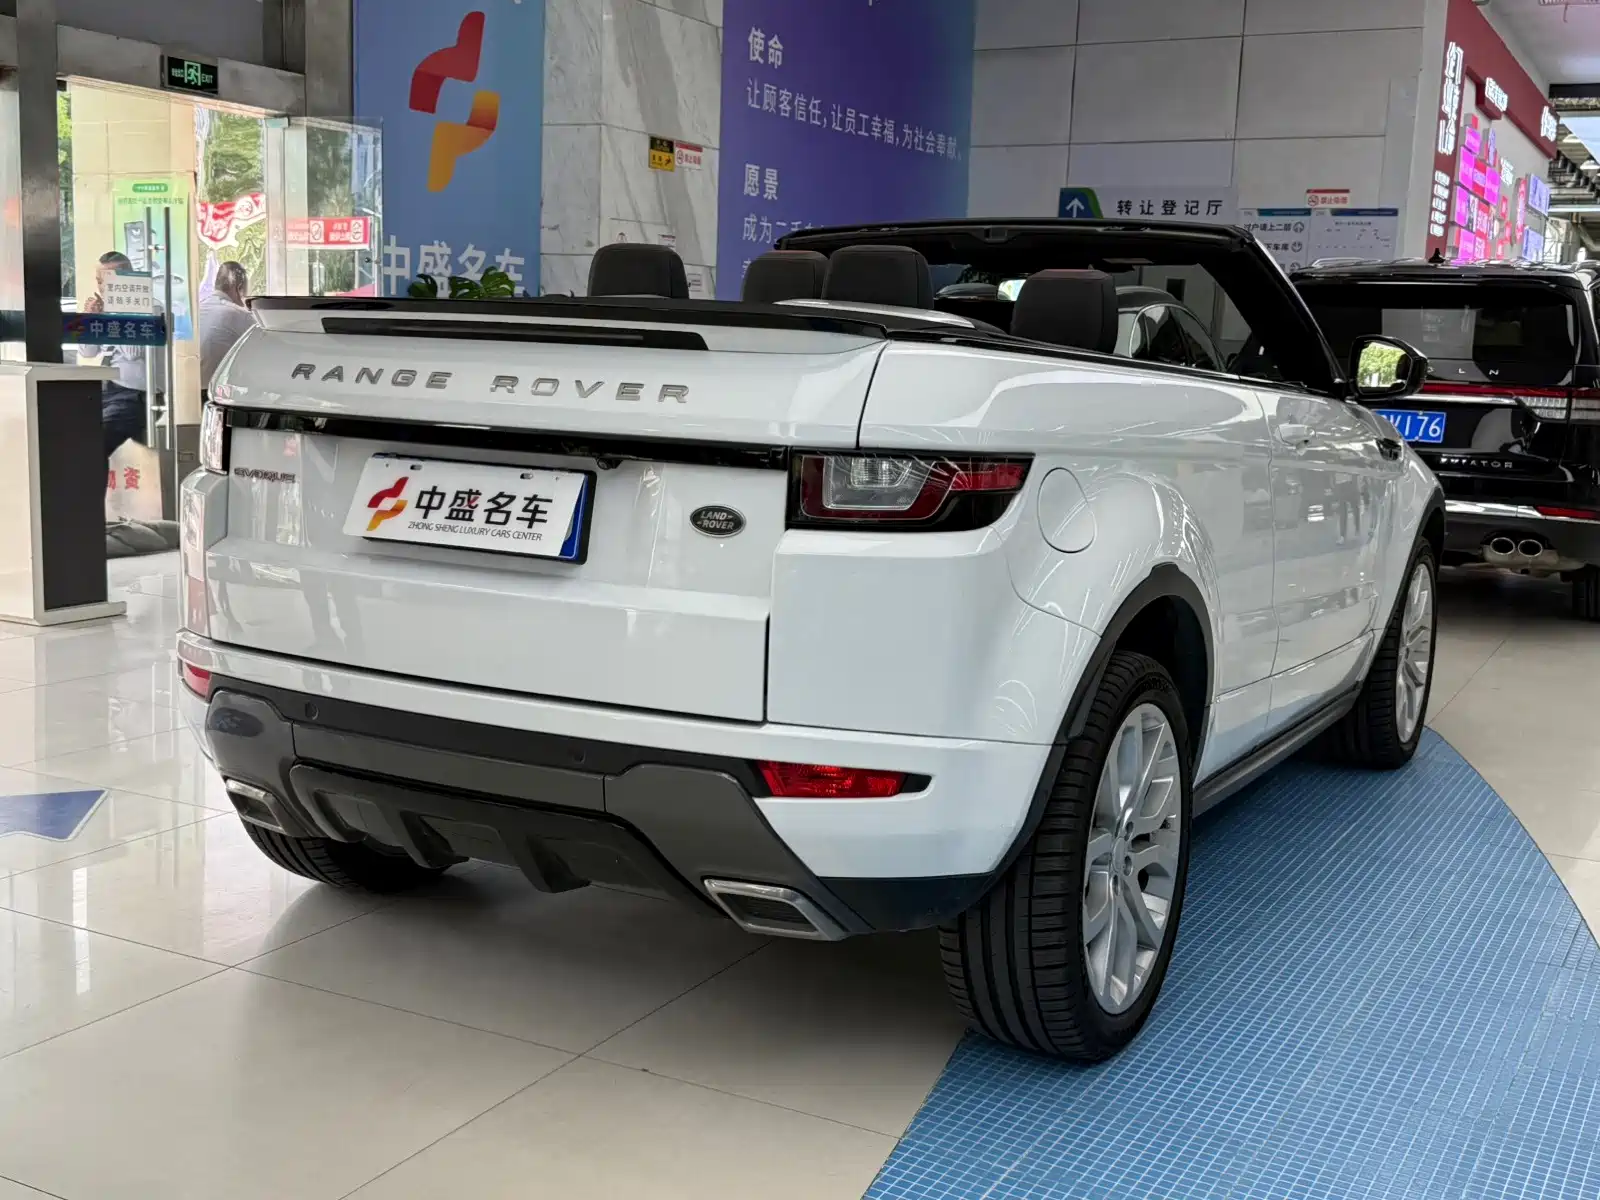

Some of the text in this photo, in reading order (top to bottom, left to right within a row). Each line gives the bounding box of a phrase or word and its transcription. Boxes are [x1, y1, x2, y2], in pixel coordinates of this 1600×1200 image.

[748, 27, 783, 69] 使命
[201, 73, 213, 83] EXIT
[743, 164, 778, 200] 愿景
[1117, 199, 1223, 216] 转让登记厅
[90, 320, 156, 339] 中盛名车
[291, 362, 690, 404] RANGE ROVER
[234, 467, 296, 484] EVOQUE
[415, 485, 553, 529] 中盛名车
[408, 521, 543, 541] ZHONG SHENG LUXURY CARS CENTER
